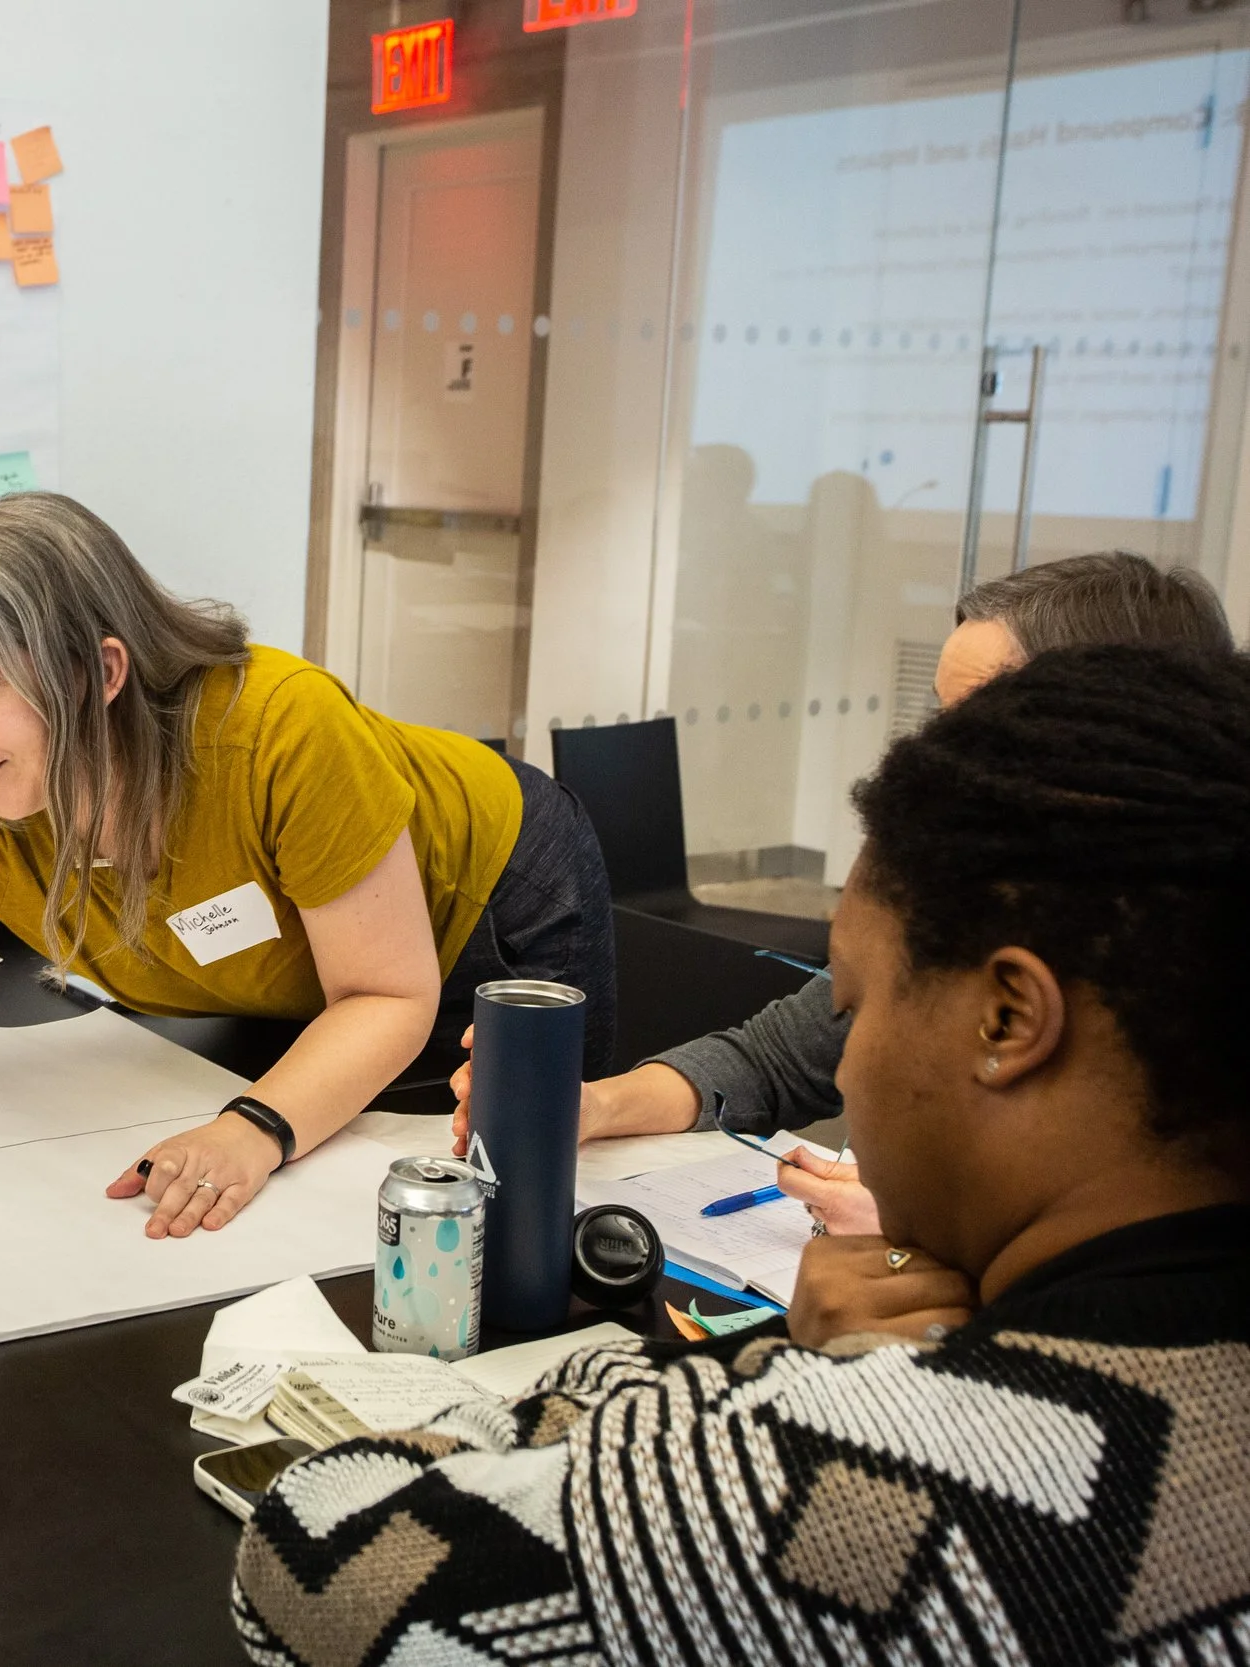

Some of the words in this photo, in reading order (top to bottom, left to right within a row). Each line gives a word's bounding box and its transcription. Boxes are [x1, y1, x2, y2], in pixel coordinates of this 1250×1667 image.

[382, 25, 444, 101] EXIT
[171, 903, 233, 935] Michelle
[200, 918, 240, 936] Johnson
[378, 1210, 398, 1235] 365
